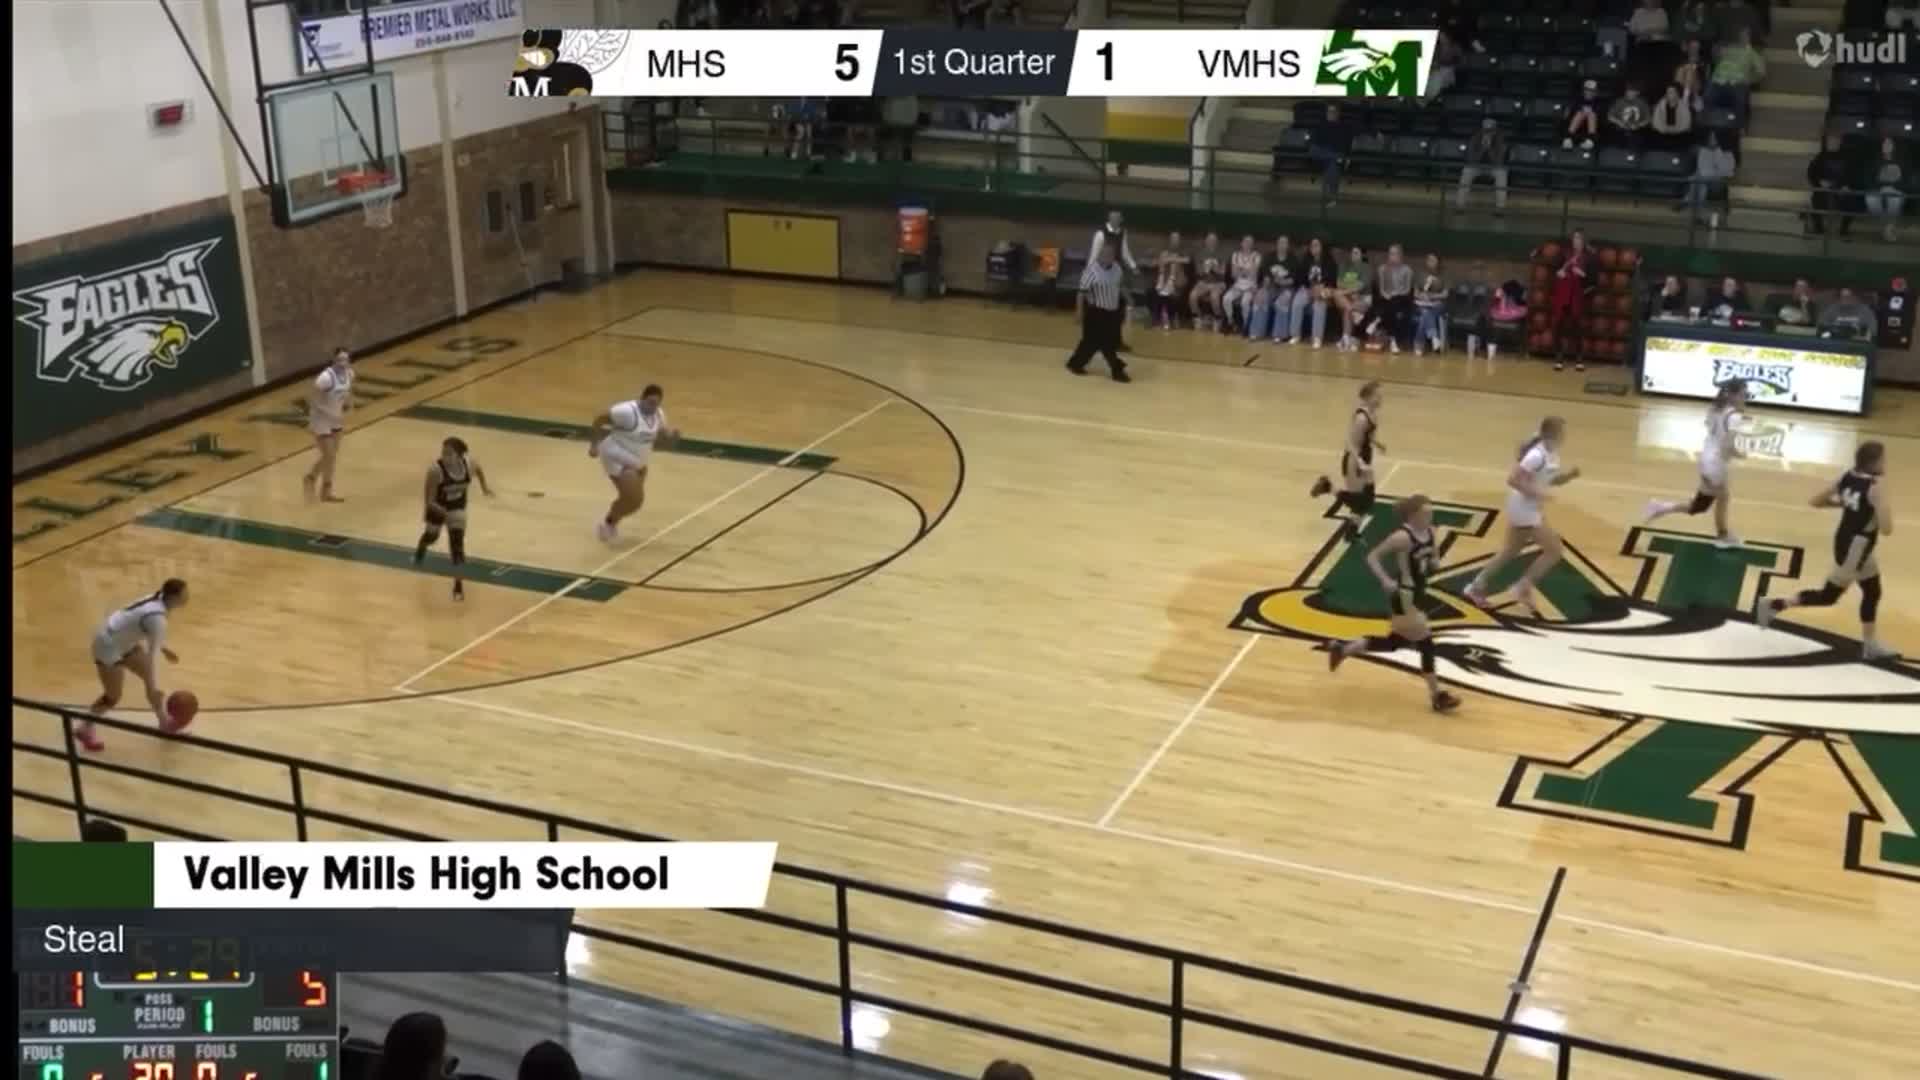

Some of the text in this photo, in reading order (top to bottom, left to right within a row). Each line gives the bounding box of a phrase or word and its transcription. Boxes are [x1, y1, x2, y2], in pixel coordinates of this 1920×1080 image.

[414, 8, 451, 32] METAL
[18, 241, 218, 370] EAGLES
[1714, 359, 1793, 391] EAGLES
[134, 1007, 185, 1023] PERIOD
[204, 999, 215, 1033] 1
[50, 1017, 97, 1034] BONUS
[253, 1016, 301, 1032] BONUS
[22, 1045, 65, 1060] FOULS
[123, 1044, 176, 1060] PLAYER
[195, 1044, 237, 1059] FOULS
[285, 1043, 328, 1058] FOULS
